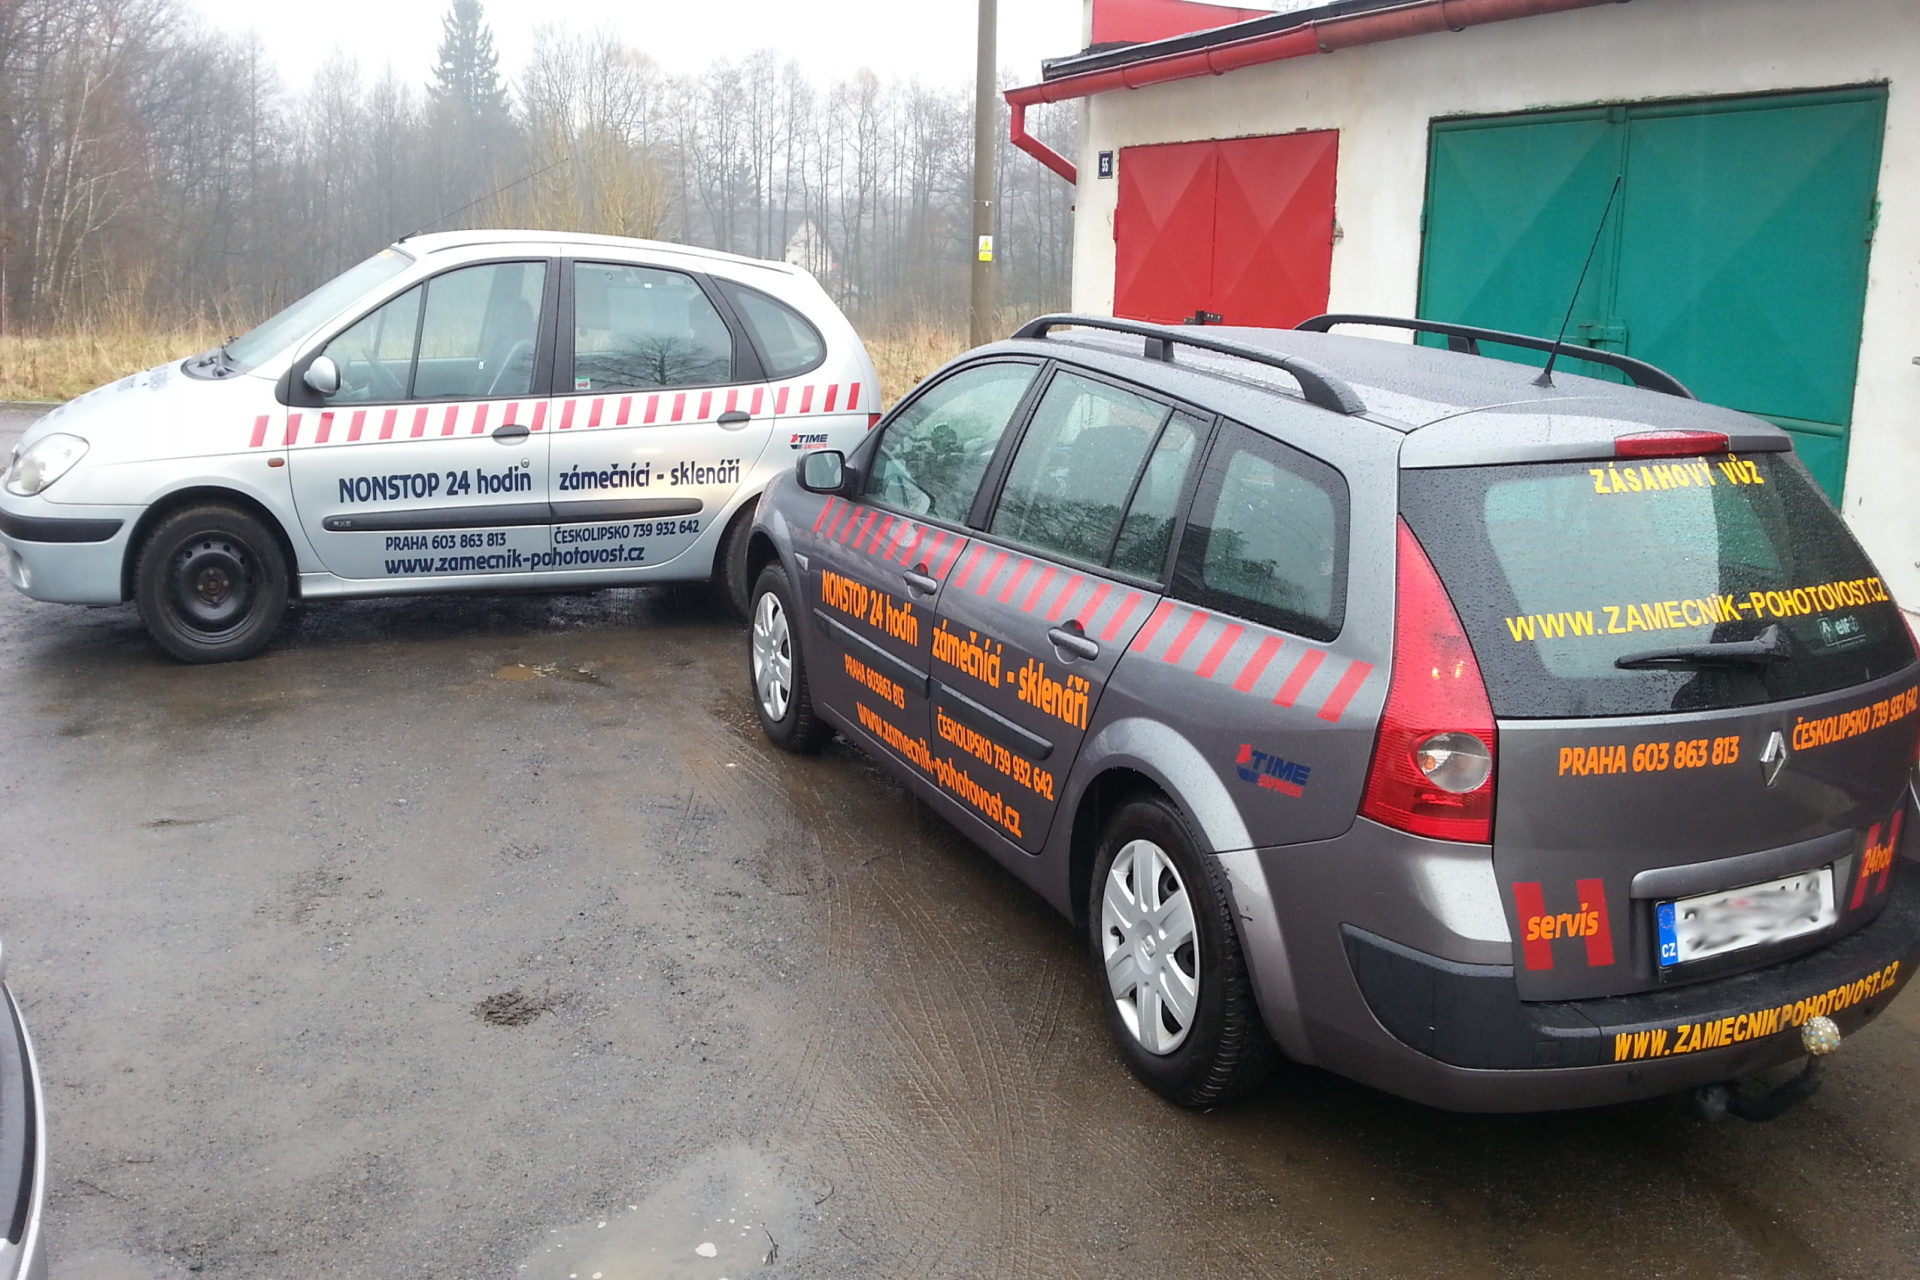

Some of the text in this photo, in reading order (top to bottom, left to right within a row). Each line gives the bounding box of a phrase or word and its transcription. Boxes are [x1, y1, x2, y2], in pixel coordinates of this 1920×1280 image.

[1101, 157, 1109, 173] 55
[798, 433, 829, 443] TIME
[338, 465, 532, 503] NONSTOP 24 hodin
[559, 461, 651, 491] zámečníci
[670, 458, 741, 486] sklenáři
[1588, 453, 1765, 494] ZÁSAHOVÝ VŮZ
[385, 532, 507, 551] PRAHA 603 863 813
[554, 519, 700, 545] ČESKOLIPSKO 739 932 642
[384, 543, 645, 574] www.zamecnik-pohotovost.cz
[822, 569, 918, 647] NONSTOP 24 hodin
[844, 653, 867, 686] PRAHA
[892, 682, 905, 710] 813
[932, 618, 1002, 689] zámečníci
[1017, 657, 1090, 731] sklenáři
[1792, 706, 1871, 751] ČESKOLIPSKO
[1870, 699, 1889, 730] 739
[1889, 692, 1905, 723] 932
[856, 701, 1022, 838] www.zamecnik-pohotovost.cz
[937, 706, 1054, 801] ČESKOLIPSKO 739 932 642
[1251, 750, 1311, 787] TIME
[1558, 735, 1740, 776] PRAHA 603 863 813
[1526, 902, 1599, 941] servis
[1661, 942, 1677, 958] CZ
